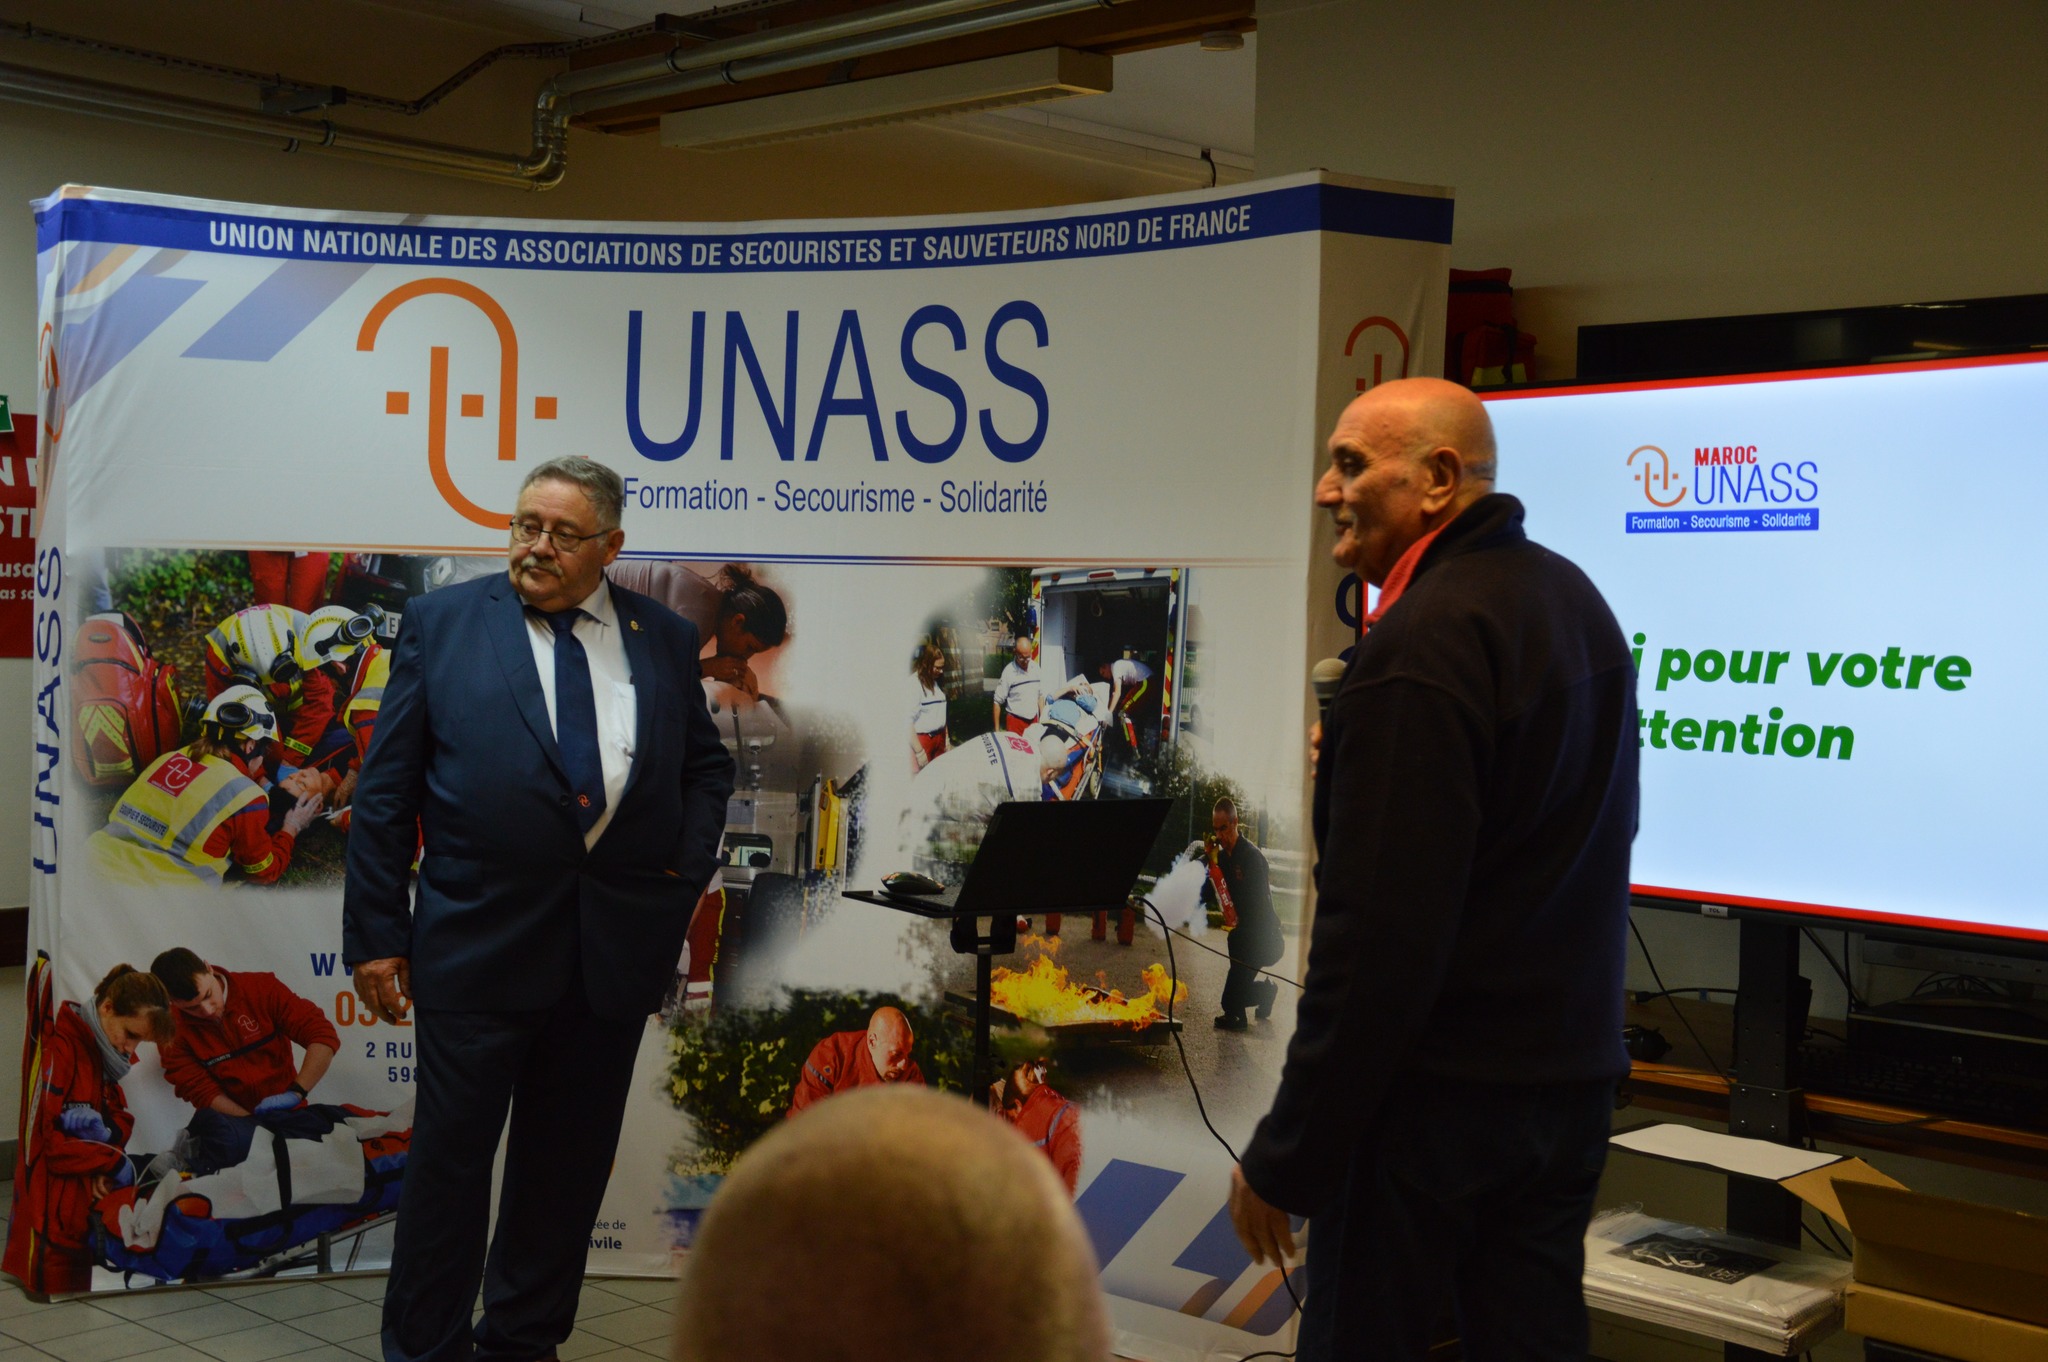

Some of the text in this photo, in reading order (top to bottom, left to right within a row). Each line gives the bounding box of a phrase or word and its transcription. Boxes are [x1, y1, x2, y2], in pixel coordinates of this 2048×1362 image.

[209, 204, 1252, 267] UNION NATIONALE DES ASSOCIATIONS DE SECOURISTES ET SAUVETEURS NORD DE FRANCE
[625, 300, 1050, 464] UNASS
[1695, 445, 1758, 466] MAROC
[623, 477, 748, 511] Formation
[775, 480, 915, 512] Secourisme
[939, 479, 1048, 513] Solidarité
[1695, 461, 1819, 505] UNASS
[1632, 516, 1680, 530] Formation
[1691, 514, 1750, 529] Secourisme
[1762, 513, 1811, 527] Solidarité
[1655, 647, 1791, 692] pour
[1806, 646, 1972, 692] votre
[33, 546, 61, 874] UNASS
[366, 1042, 376, 1058] 2
[612, 1219, 626, 1230] de
